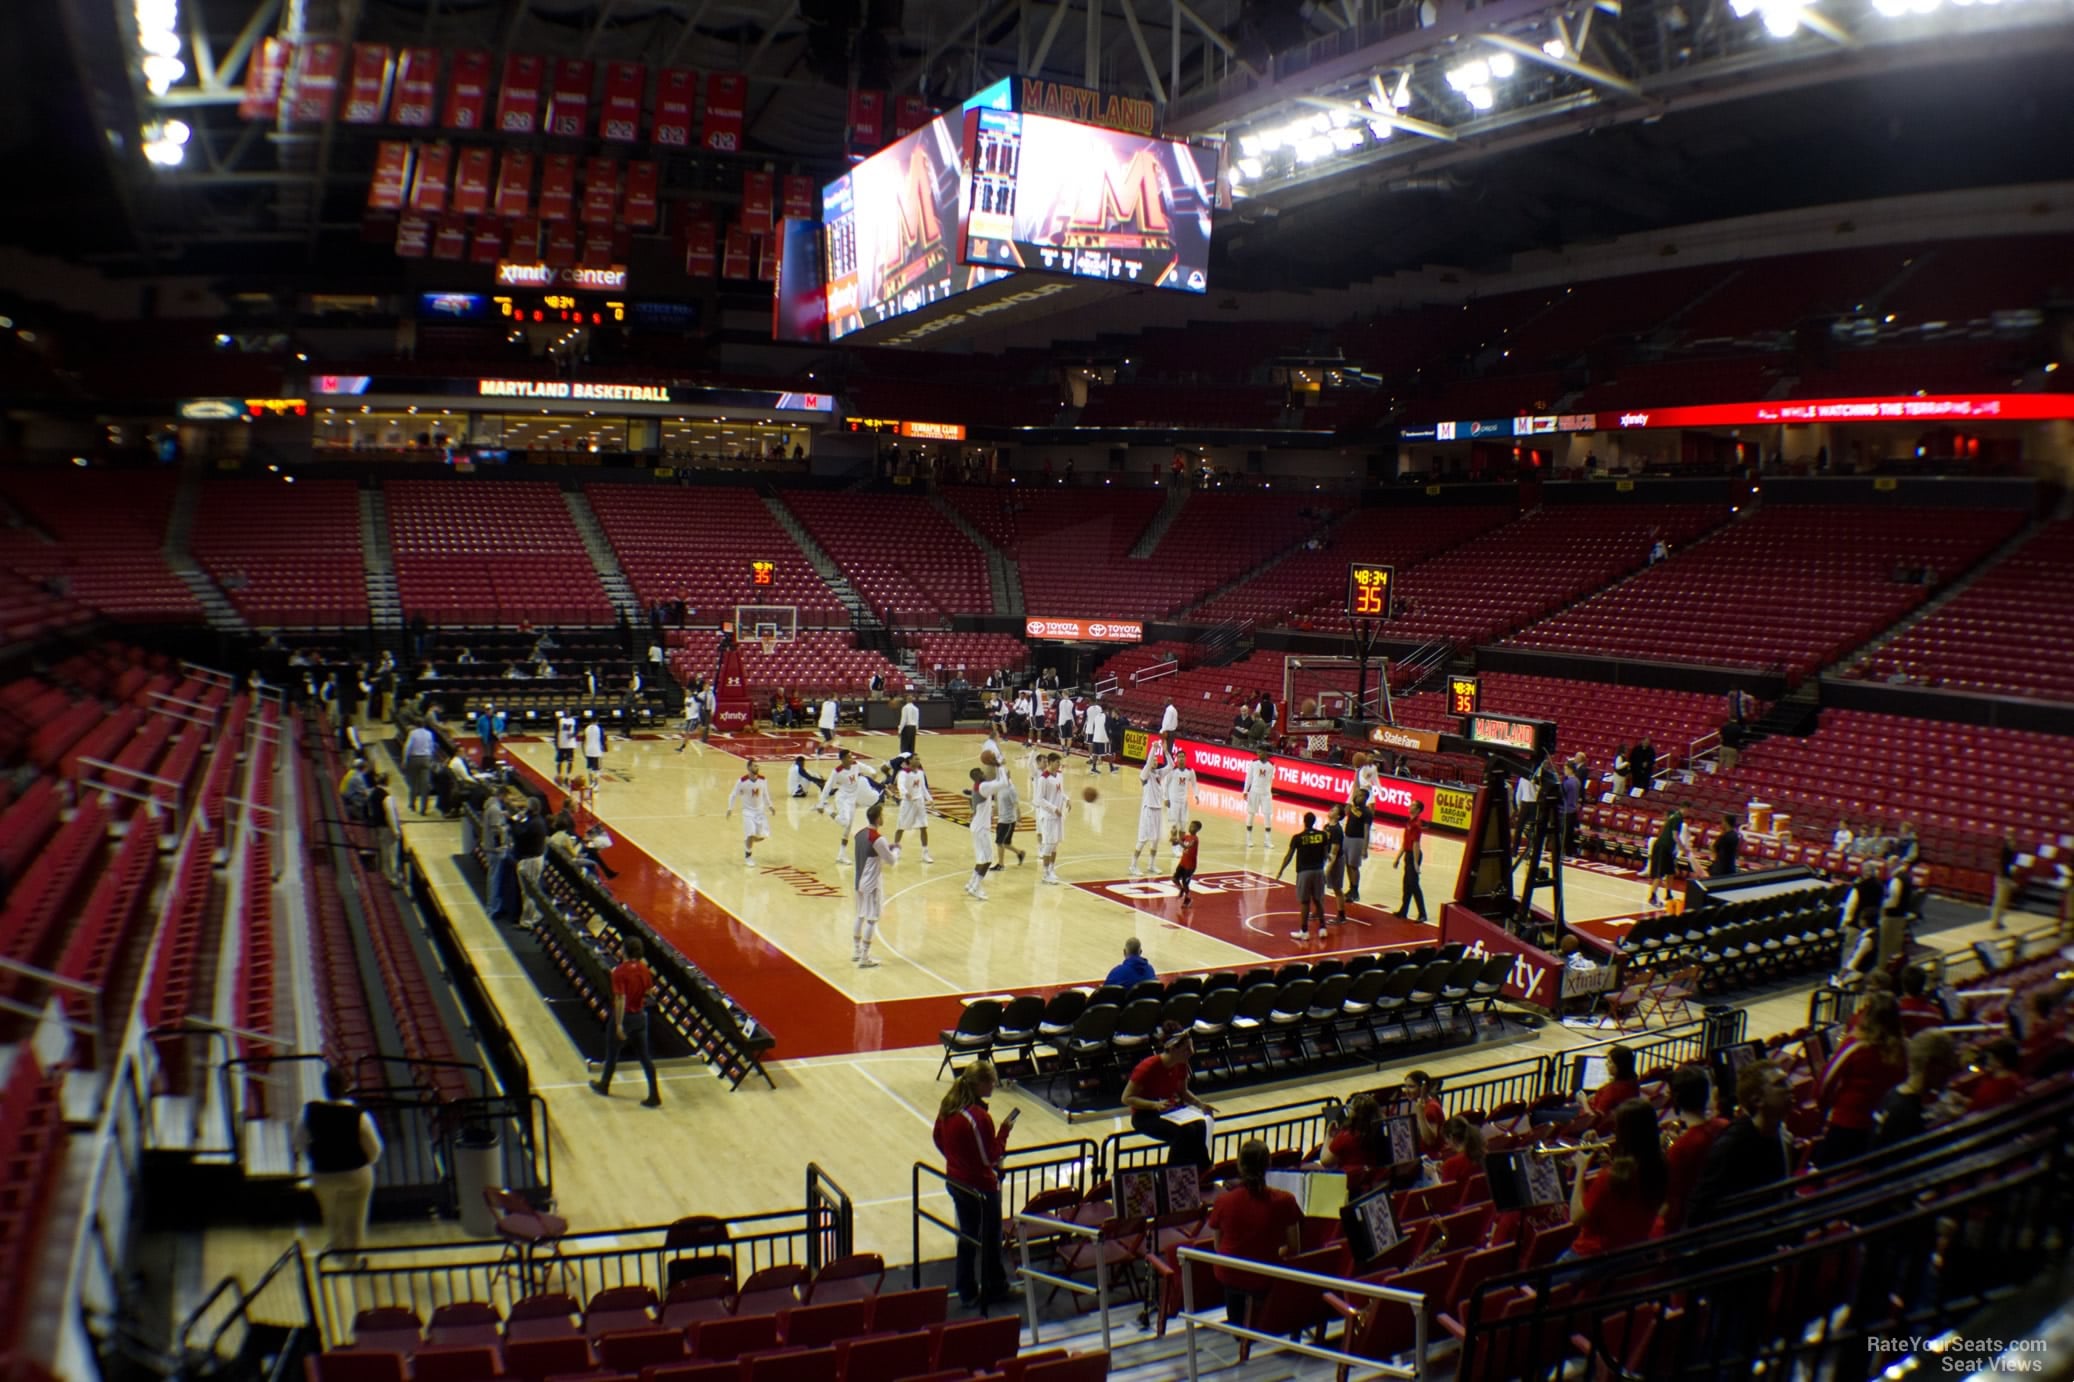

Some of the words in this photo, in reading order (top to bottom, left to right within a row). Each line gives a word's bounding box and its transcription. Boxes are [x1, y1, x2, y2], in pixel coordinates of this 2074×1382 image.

[1021, 78, 1154, 132] MARYLAND
[1068, 149, 1170, 234] M
[883, 145, 942, 275] M
[499, 264, 556, 284] xfinity
[561, 267, 626, 285] center
[479, 379, 570, 398] MARYLAND
[572, 383, 670, 401] BASKETBALL
[804, 394, 817, 409] M
[1620, 412, 1649, 428] xfinity
[754, 571, 771, 584] 35
[1354, 570, 1387, 585] 48:34
[1357, 586, 1382, 613] 35
[1045, 622, 1079, 631] TOYOTA
[1107, 624, 1141, 633] TOYOTA
[1453, 682, 1475, 695] 48:34
[1456, 696, 1471, 713] 35
[719, 711, 746, 721] xfinity
[1476, 718, 1533, 744] MARYLAND
[1195, 750, 1221, 768] YOUR
[1278, 767, 1299, 784] THE
[1300, 772, 1333, 790] MOST
[1335, 778, 1353, 794] LIV
[1371, 785, 1412, 806] PORTS
[1258, 768, 1267, 777] M
[1178, 777, 1186, 785] M
[751, 787, 760, 798] M
[1440, 807, 1467, 819] BARGAIN
[1441, 815, 1464, 826] OUTLET
[1567, 970, 1611, 995] xfinity
